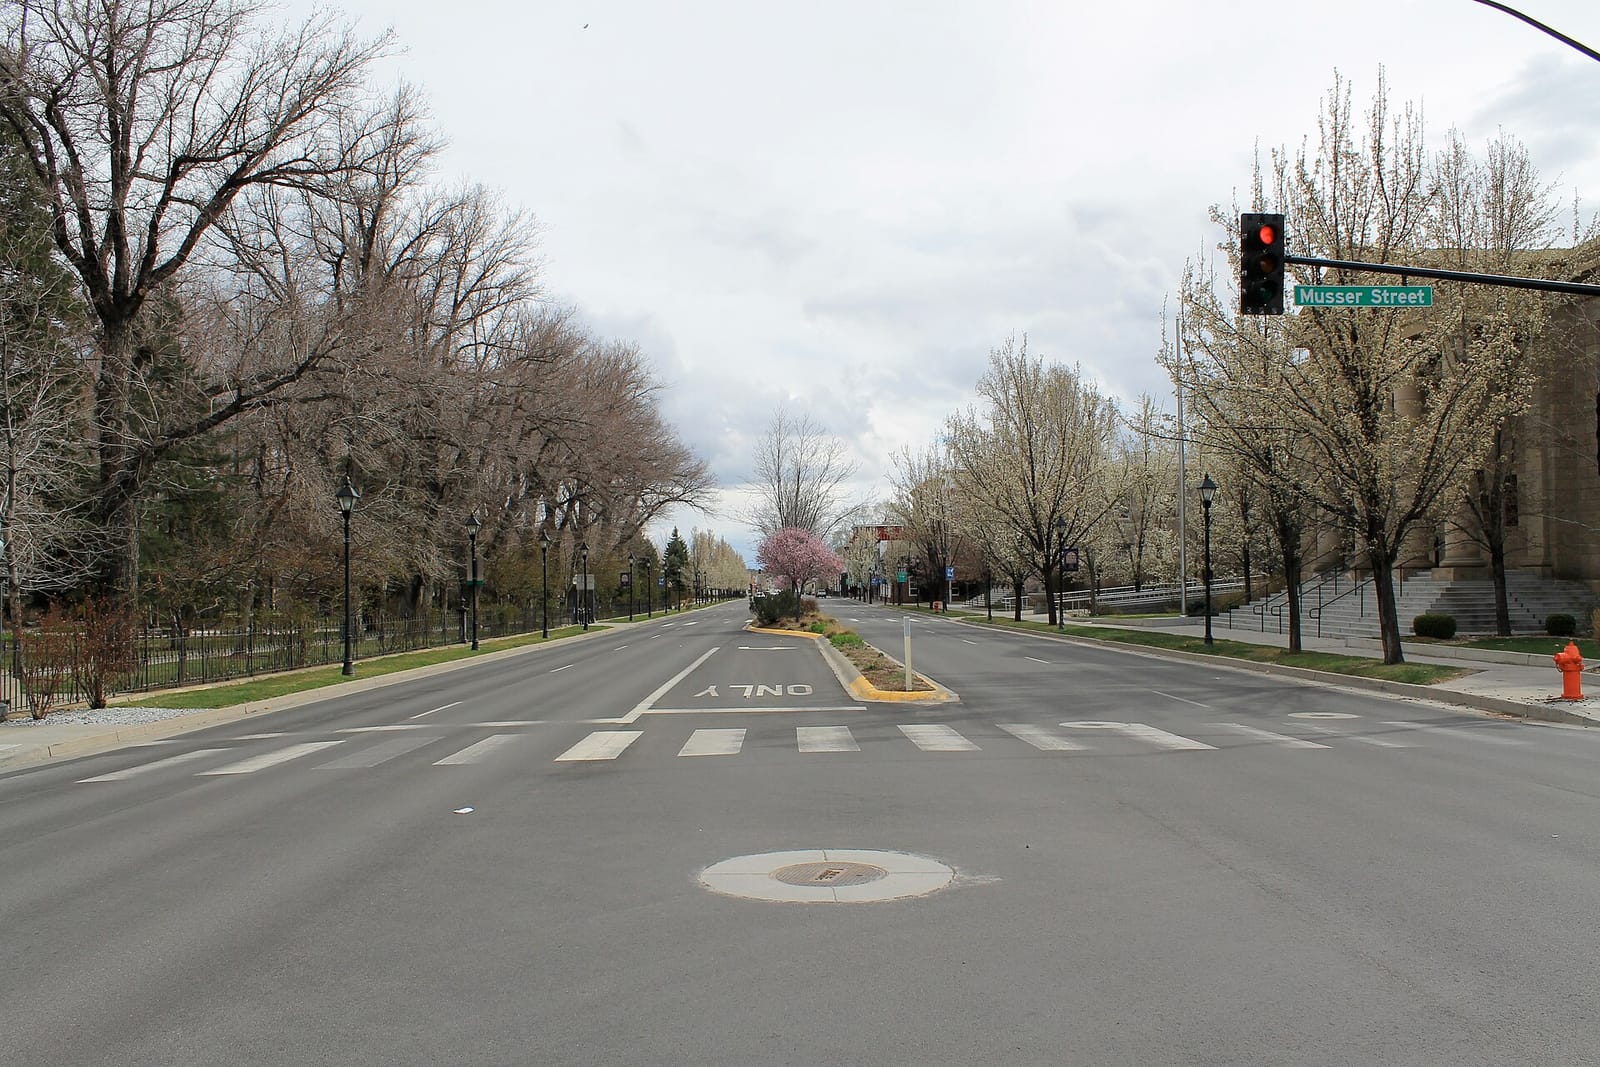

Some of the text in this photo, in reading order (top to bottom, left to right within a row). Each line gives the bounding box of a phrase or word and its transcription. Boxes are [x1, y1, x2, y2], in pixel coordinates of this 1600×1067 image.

[1300, 288, 1425, 304] Musser Street
[693, 684, 814, 698] ONLY
